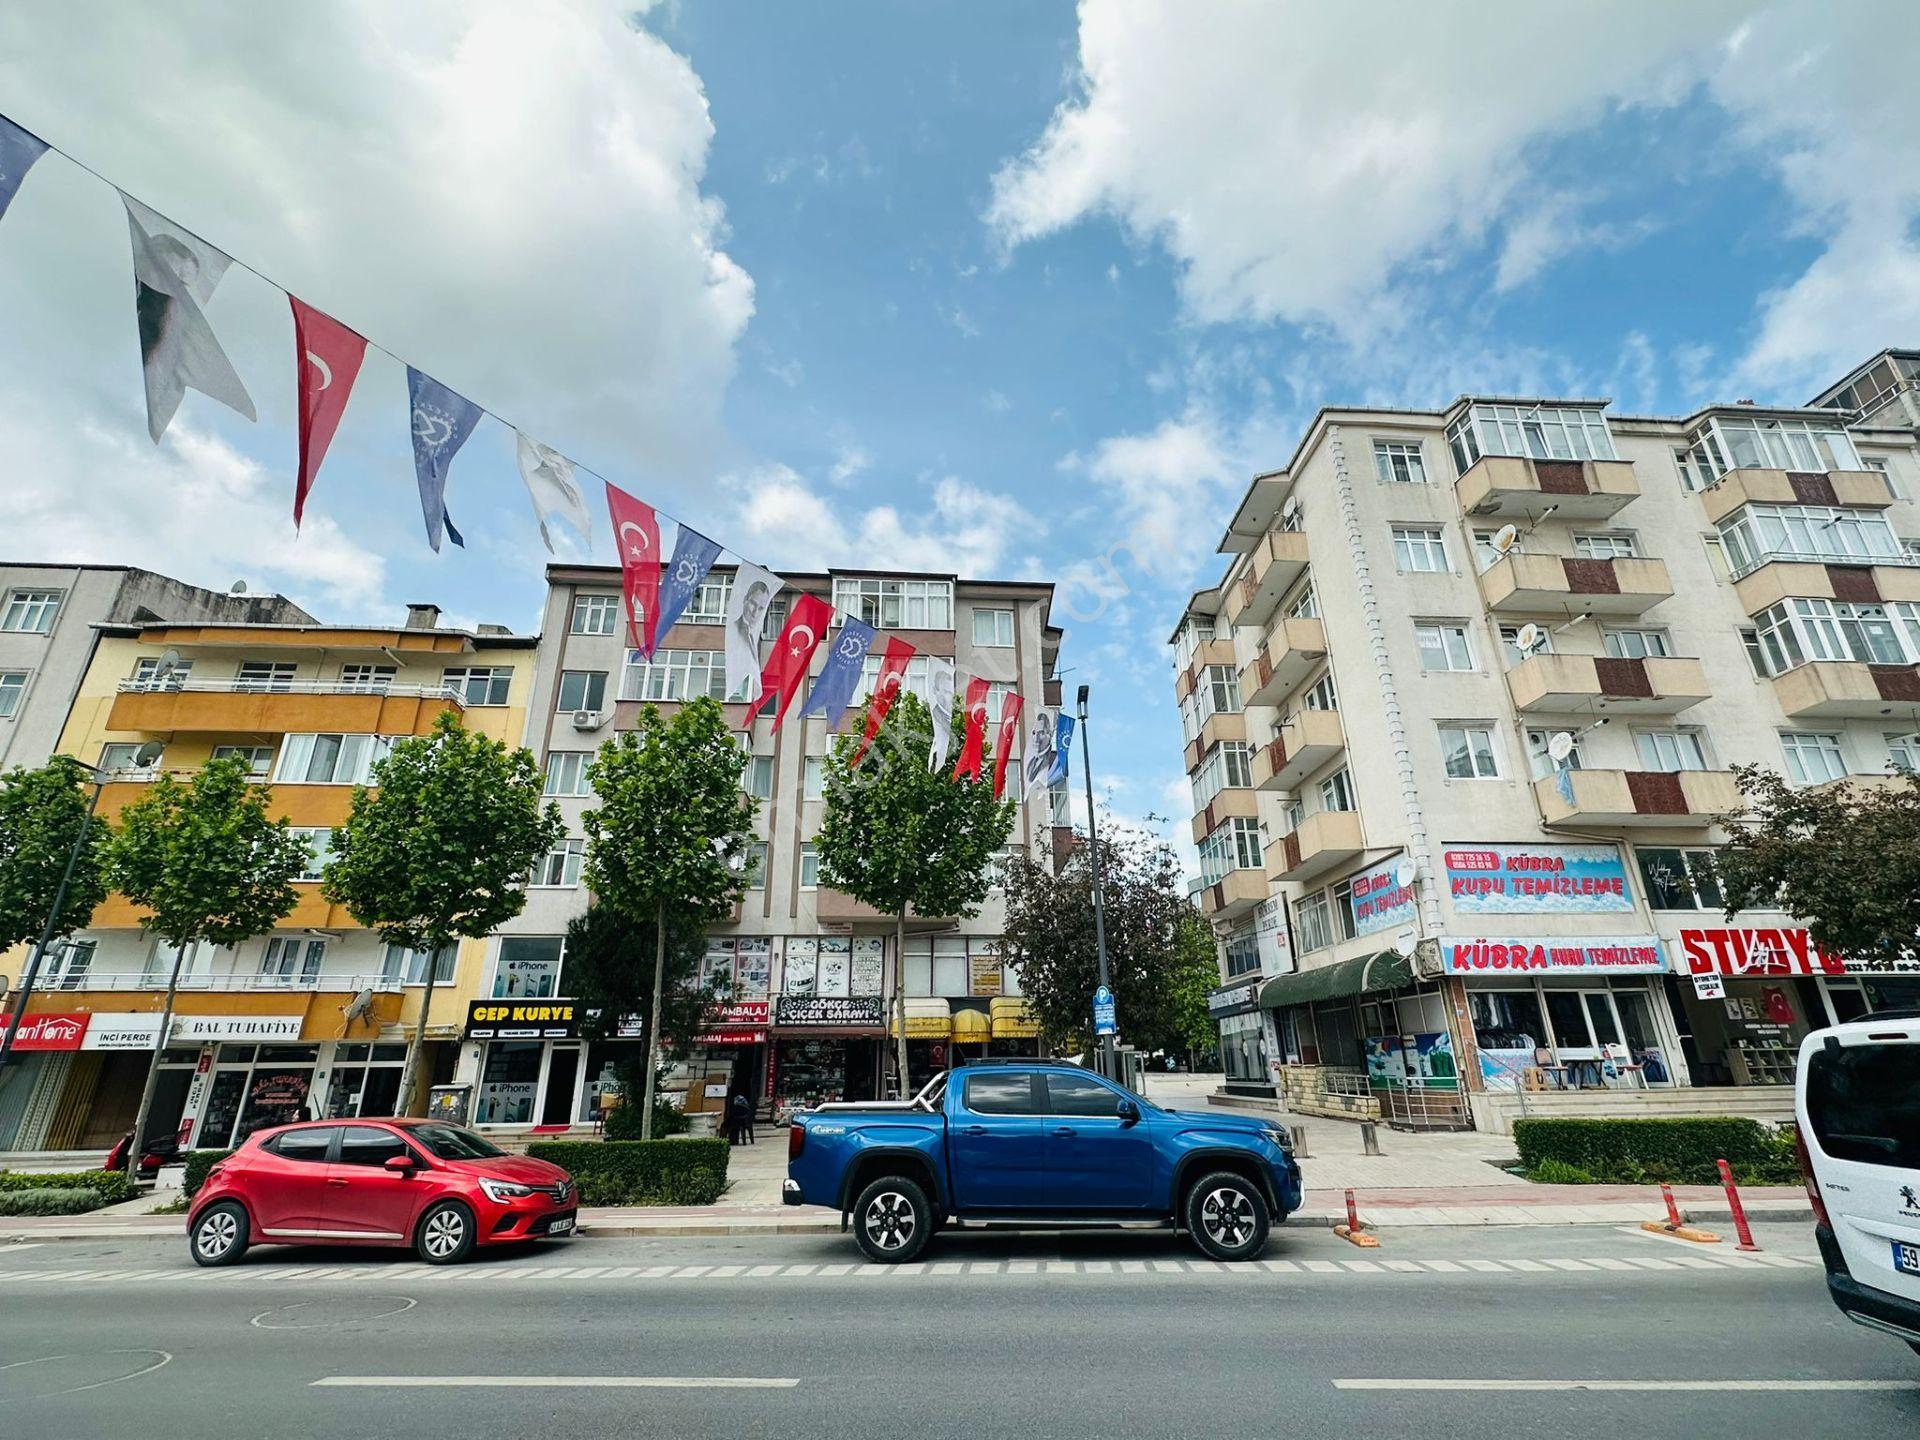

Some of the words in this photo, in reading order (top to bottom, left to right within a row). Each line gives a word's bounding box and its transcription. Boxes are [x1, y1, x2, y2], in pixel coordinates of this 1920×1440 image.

[1506, 853, 1565, 872] KÜBRA
[1451, 878, 1505, 895] KURU
[1512, 872, 1624, 895] TEMİZLEME
[1452, 939, 1548, 971] KÜBRA
[1549, 947, 1586, 966] KURU
[1586, 944, 1660, 966] TEMİZLEME
[517, 961, 548, 971] iPhone
[810, 998, 850, 1010] GÖKÇE
[473, 1007, 509, 1021] CEP
[512, 1007, 573, 1021] KURYE
[721, 1006, 767, 1016] AMBALAJ
[826, 1009, 869, 1019] SARAYI
[194, 1022, 222, 1034] BAL
[227, 1019, 300, 1034] TUHAFİYE
[121, 1033, 152, 1041] PERDE
[499, 1084, 531, 1093] iPhone
[600, 1083, 622, 1092] iPho
[1902, 1247, 1919, 1269] 59
